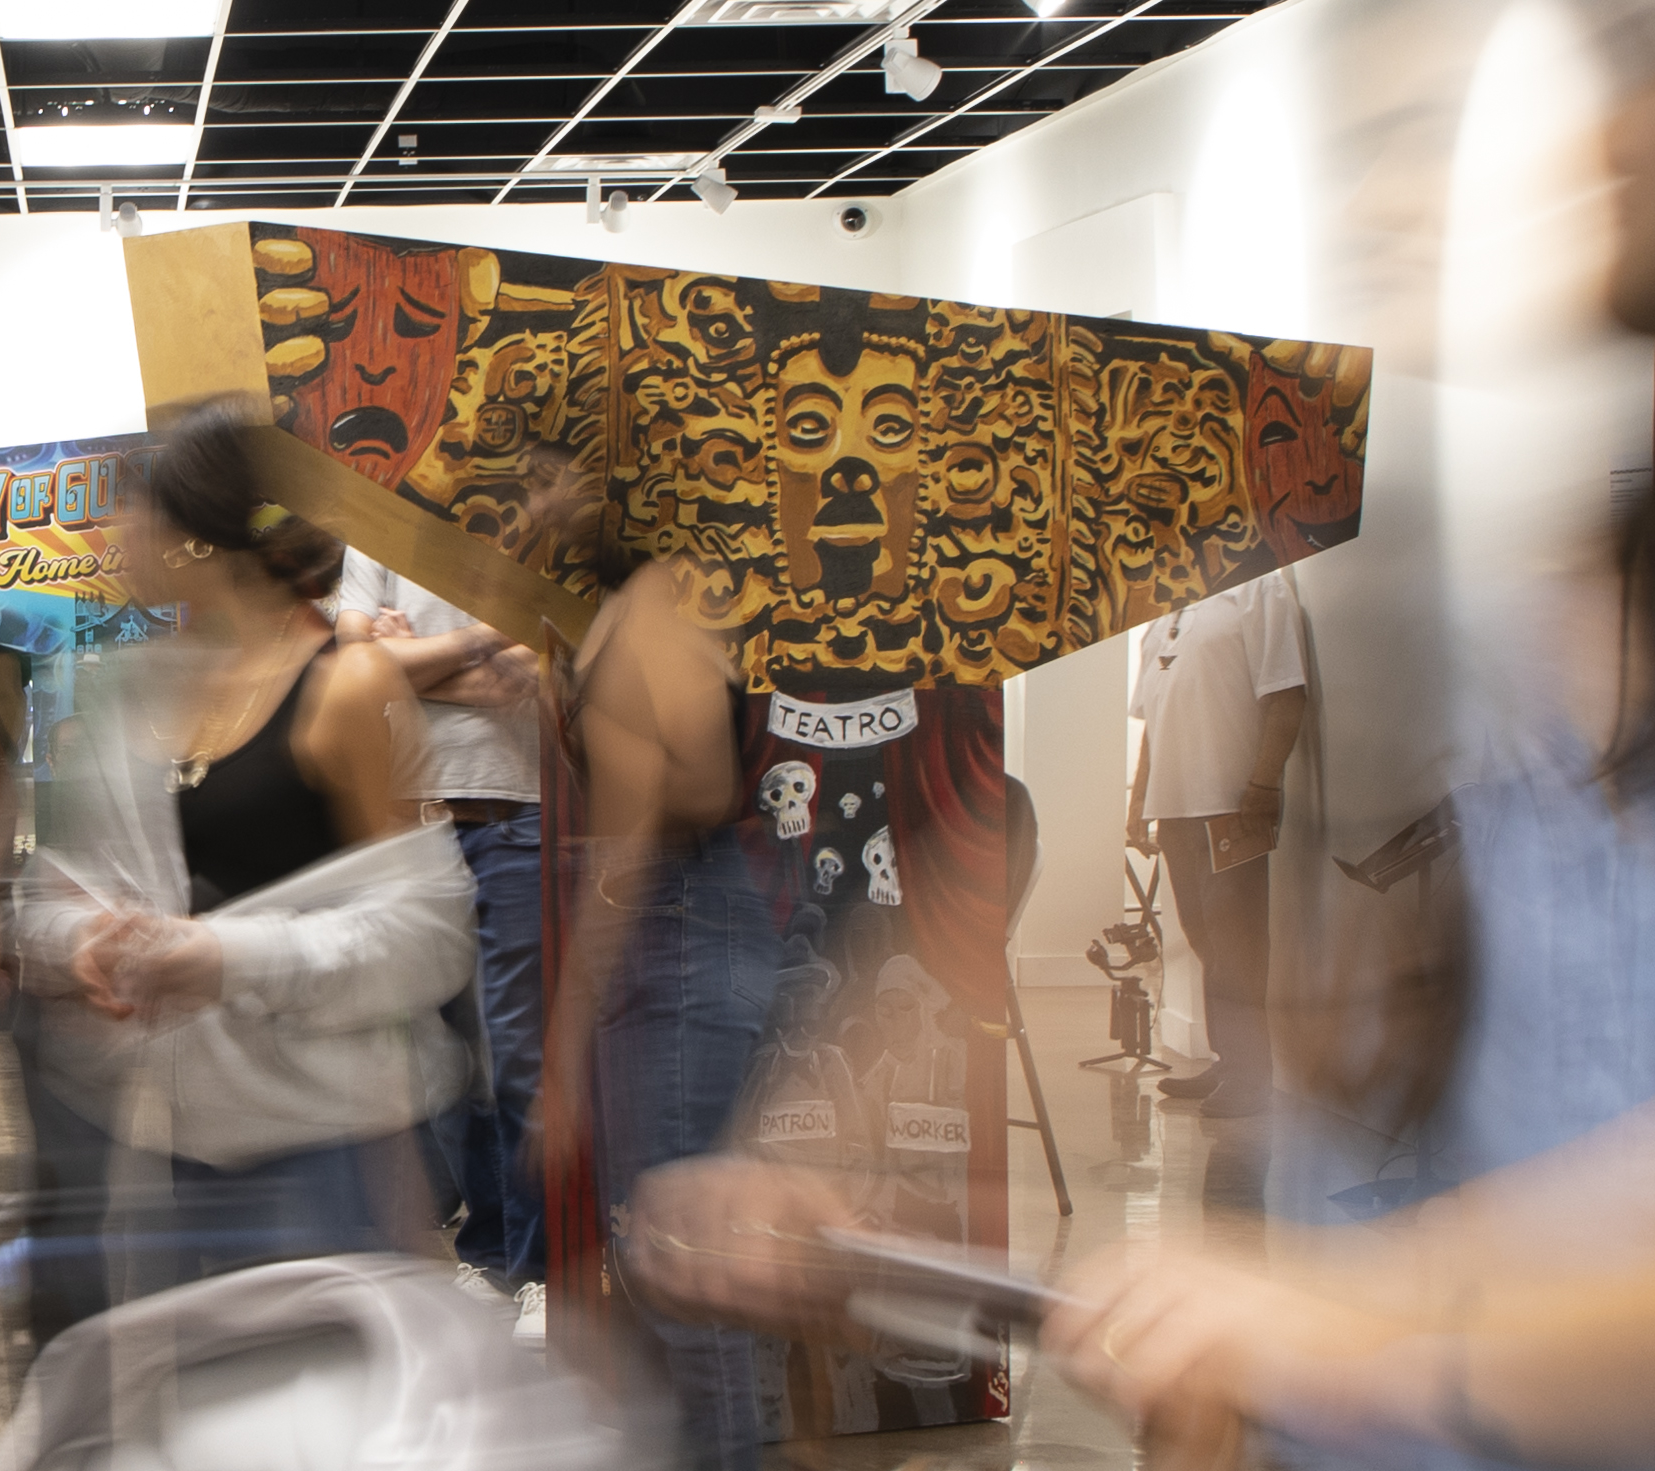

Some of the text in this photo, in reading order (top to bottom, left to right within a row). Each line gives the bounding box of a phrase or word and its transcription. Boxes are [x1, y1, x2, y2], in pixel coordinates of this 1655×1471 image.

[10, 472, 52, 522] OF
[779, 705, 902, 741] TEATRO
[762, 1107, 829, 1134] PATRÓN
[889, 1118, 968, 1145] WORKER
